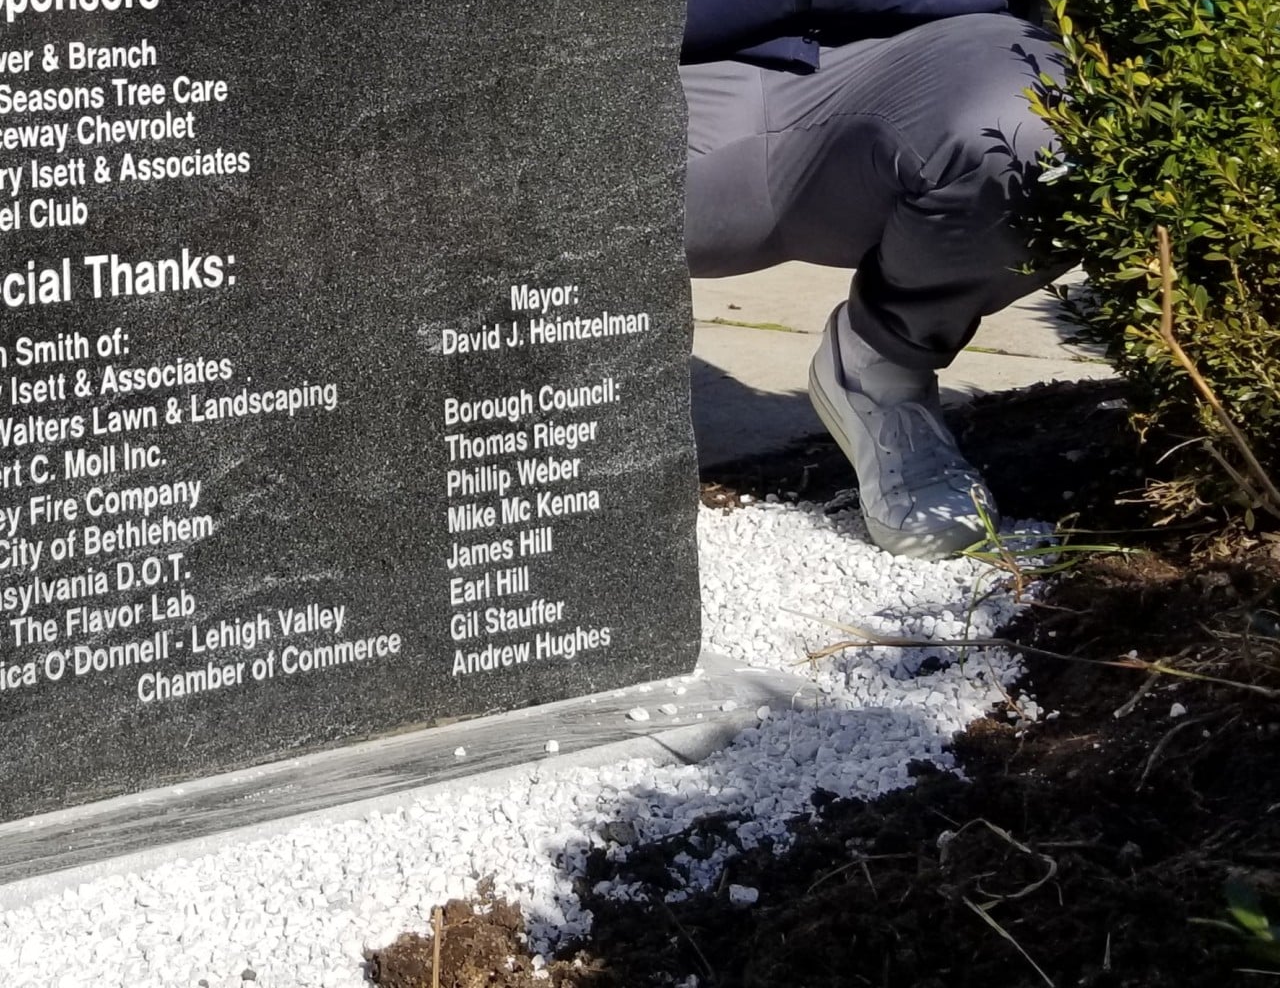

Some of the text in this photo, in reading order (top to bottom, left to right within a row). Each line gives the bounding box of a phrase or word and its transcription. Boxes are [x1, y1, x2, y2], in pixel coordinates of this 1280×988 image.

[42, 44, 59, 72] &
[69, 39, 156, 69] Branch
[112, 79, 165, 106] Tree
[173, 76, 227, 103] Care
[77, 110, 195, 145] Chevrolet
[32, 158, 85, 188] Isett
[94, 156, 111, 183] &
[120, 148, 250, 181] Associates
[30, 197, 87, 228] Club
[84, 248, 235, 298] Thanks:
[511, 285, 578, 314] Mayor:
[16, 332, 88, 365] Smith
[97, 328, 129, 357] of:
[442, 311, 649, 354] David J. Heintzelman
[12, 374, 65, 405] Isett
[75, 369, 92, 397] &
[101, 357, 232, 394] Associates
[445, 378, 620, 425] Borough Council:
[93, 407, 157, 434] Lawn
[166, 397, 182, 424] &
[191, 381, 337, 422] Landscaping
[445, 421, 597, 461] Thomas Rieger
[30, 455, 55, 484] C.
[65, 445, 115, 479] Moll
[124, 442, 166, 470] Inc.
[448, 457, 580, 496] Phillip Weber
[30, 495, 77, 525] Fire
[84, 481, 201, 516] Company
[448, 490, 600, 533] Mike Mc Kenna
[51, 529, 76, 560] of
[85, 515, 215, 555] Bethlehem
[447, 527, 552, 569] James Hill
[117, 551, 190, 590] D.O.T.
[451, 566, 529, 605] Earl Hill
[10, 617, 57, 646] The
[67, 604, 143, 637] Flavor
[152, 589, 195, 621] Lab
[192, 614, 270, 653] Lehigh
[278, 604, 344, 636] Valley
[451, 599, 564, 640] Gil Stauffer
[138, 634, 401, 703] Chamber of Commerce
[453, 626, 610, 676] Andrew Hughes
